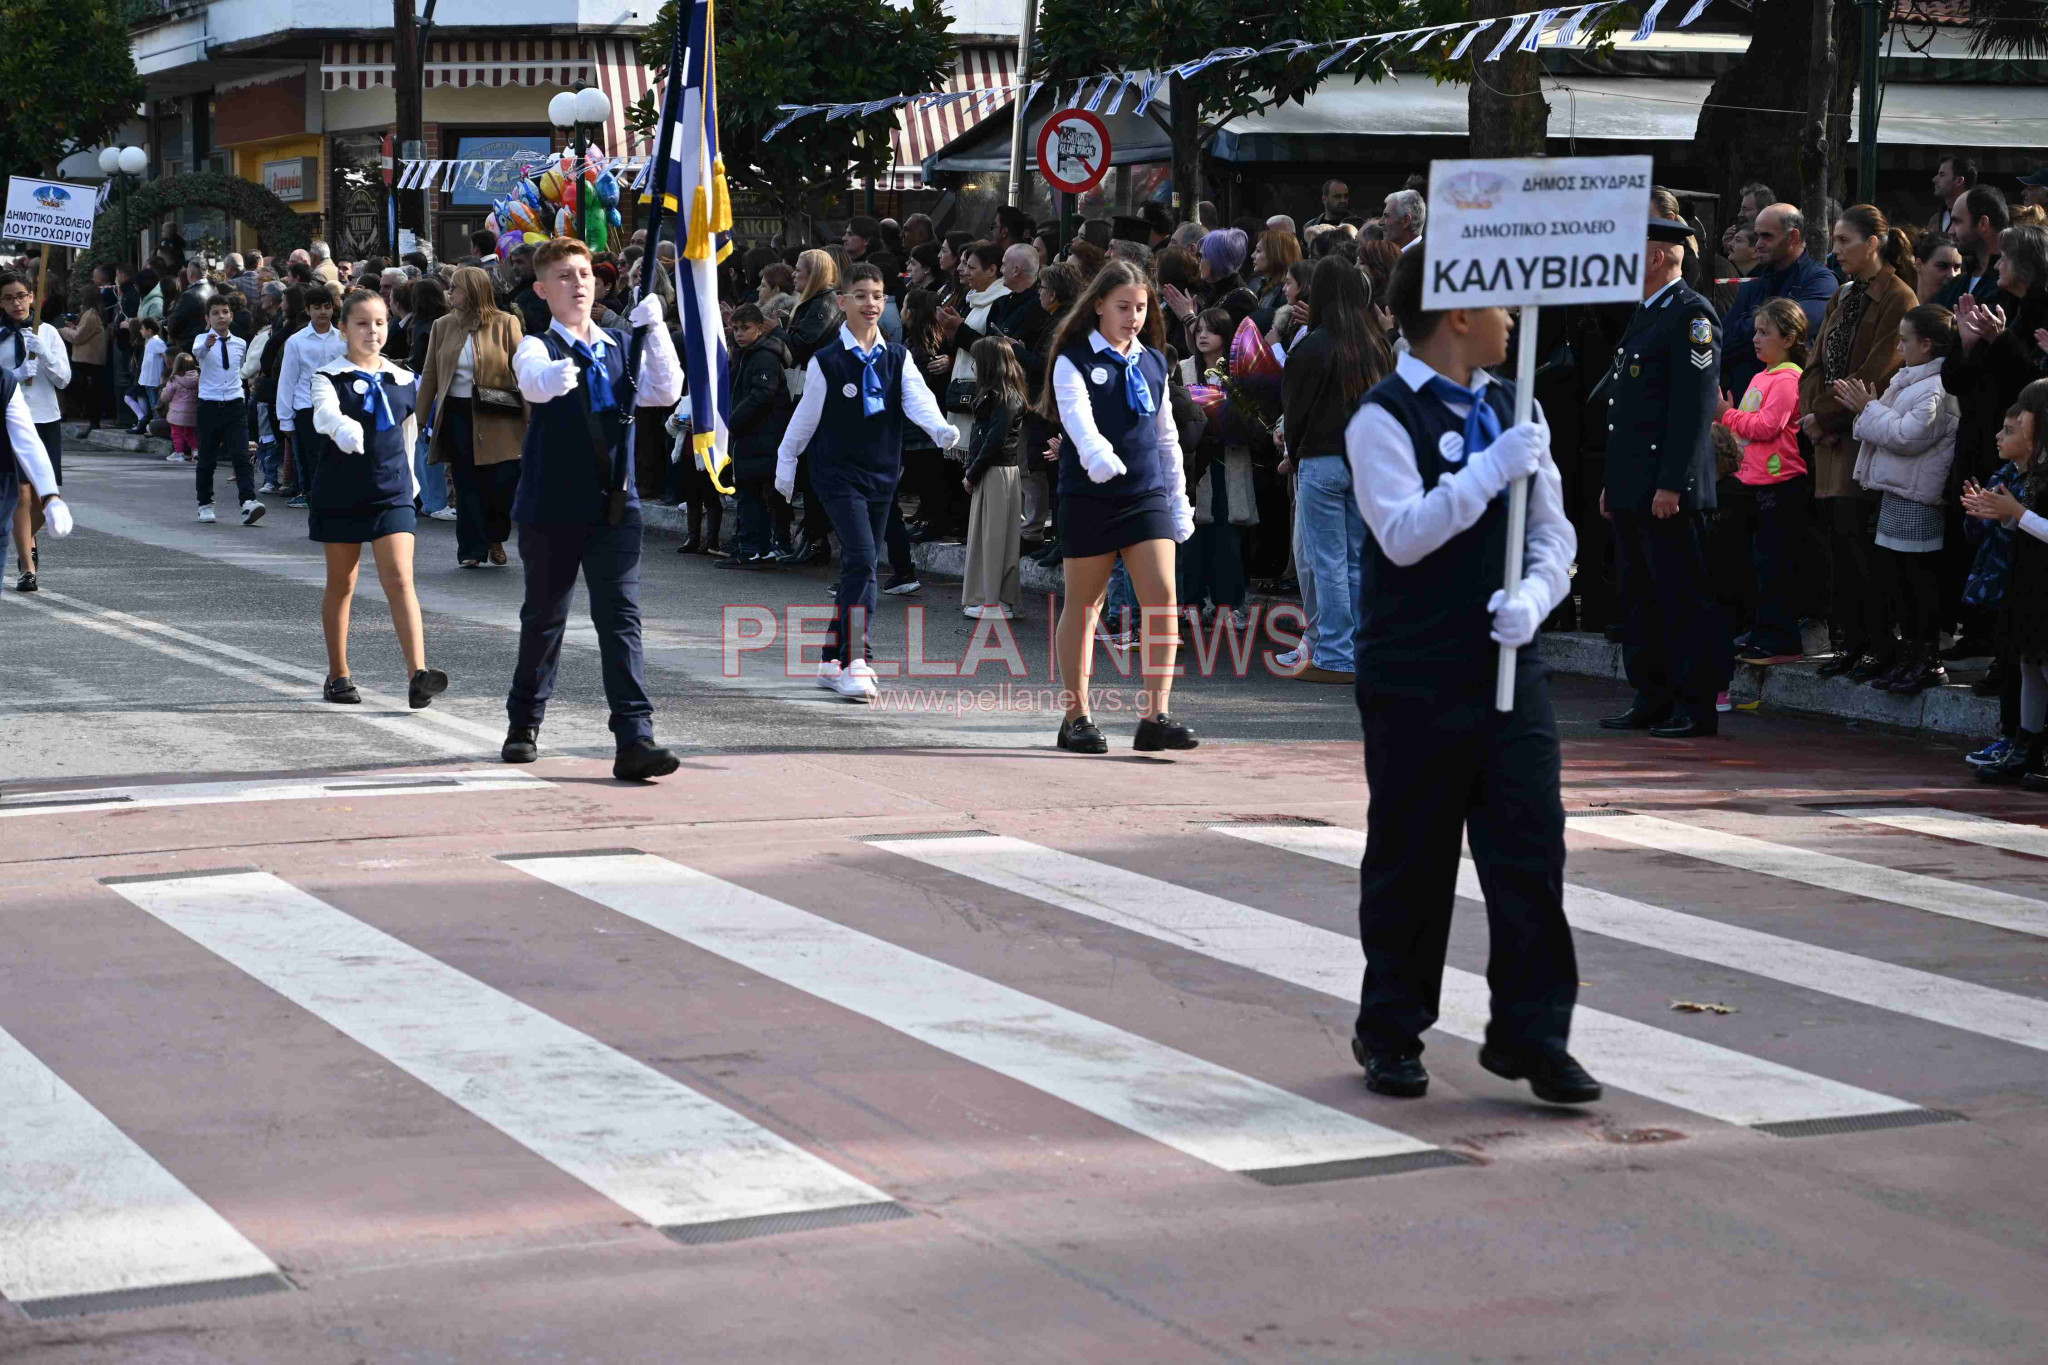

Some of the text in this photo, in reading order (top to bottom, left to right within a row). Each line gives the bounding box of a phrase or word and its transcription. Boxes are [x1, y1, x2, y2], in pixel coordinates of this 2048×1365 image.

[1522, 175, 1646, 191] ΔΗΜΟΣ ΣΚΥΔΡΑΣ
[6, 209, 92, 230] ΔΗΜΟΤΙΚΟ ΣΧΟΛΕΙΟ
[1460, 220, 1615, 239] ΔΗΜΟΤΙΚΟ ΣΧΟΛΕΙΟ
[4, 222, 91, 243] ΛΟΥΤΡΟΧΩΡΙΟΥ
[1433, 253, 1639, 293] ΚΑΛΥΒΙΩΝ
